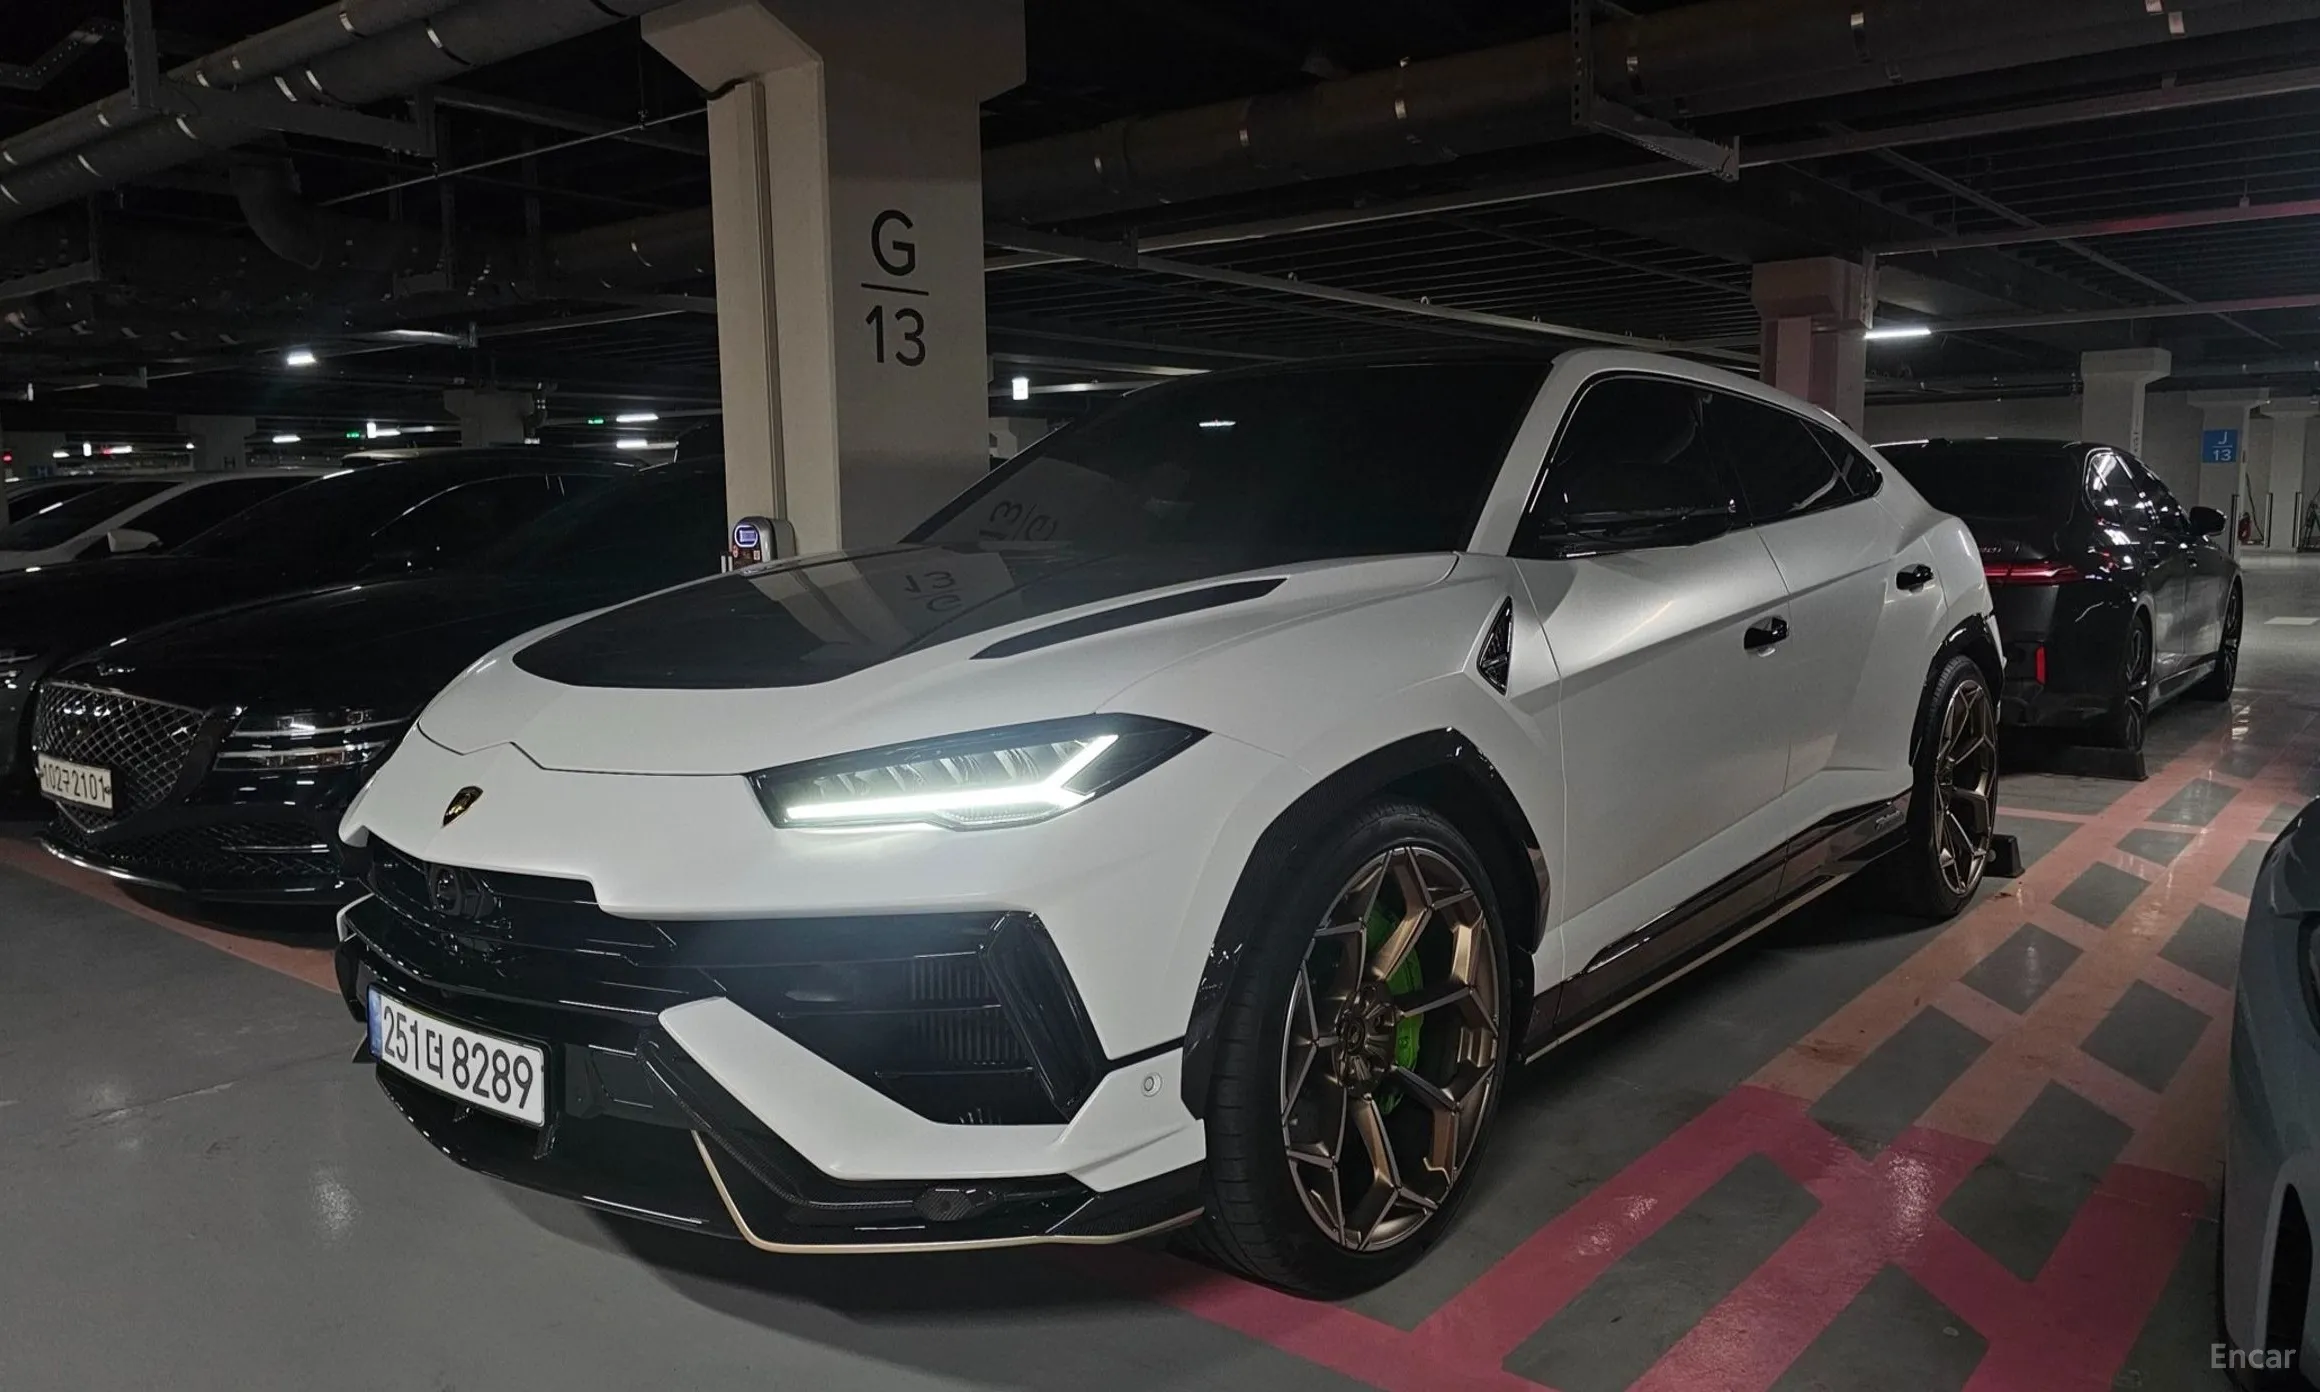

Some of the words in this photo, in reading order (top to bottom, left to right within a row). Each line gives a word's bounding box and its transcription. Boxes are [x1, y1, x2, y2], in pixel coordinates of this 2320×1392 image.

[871, 209, 916, 277] G
[865, 304, 926, 367] 13
[2212, 448, 2232, 462] 13
[2217, 431, 2229, 445] J
